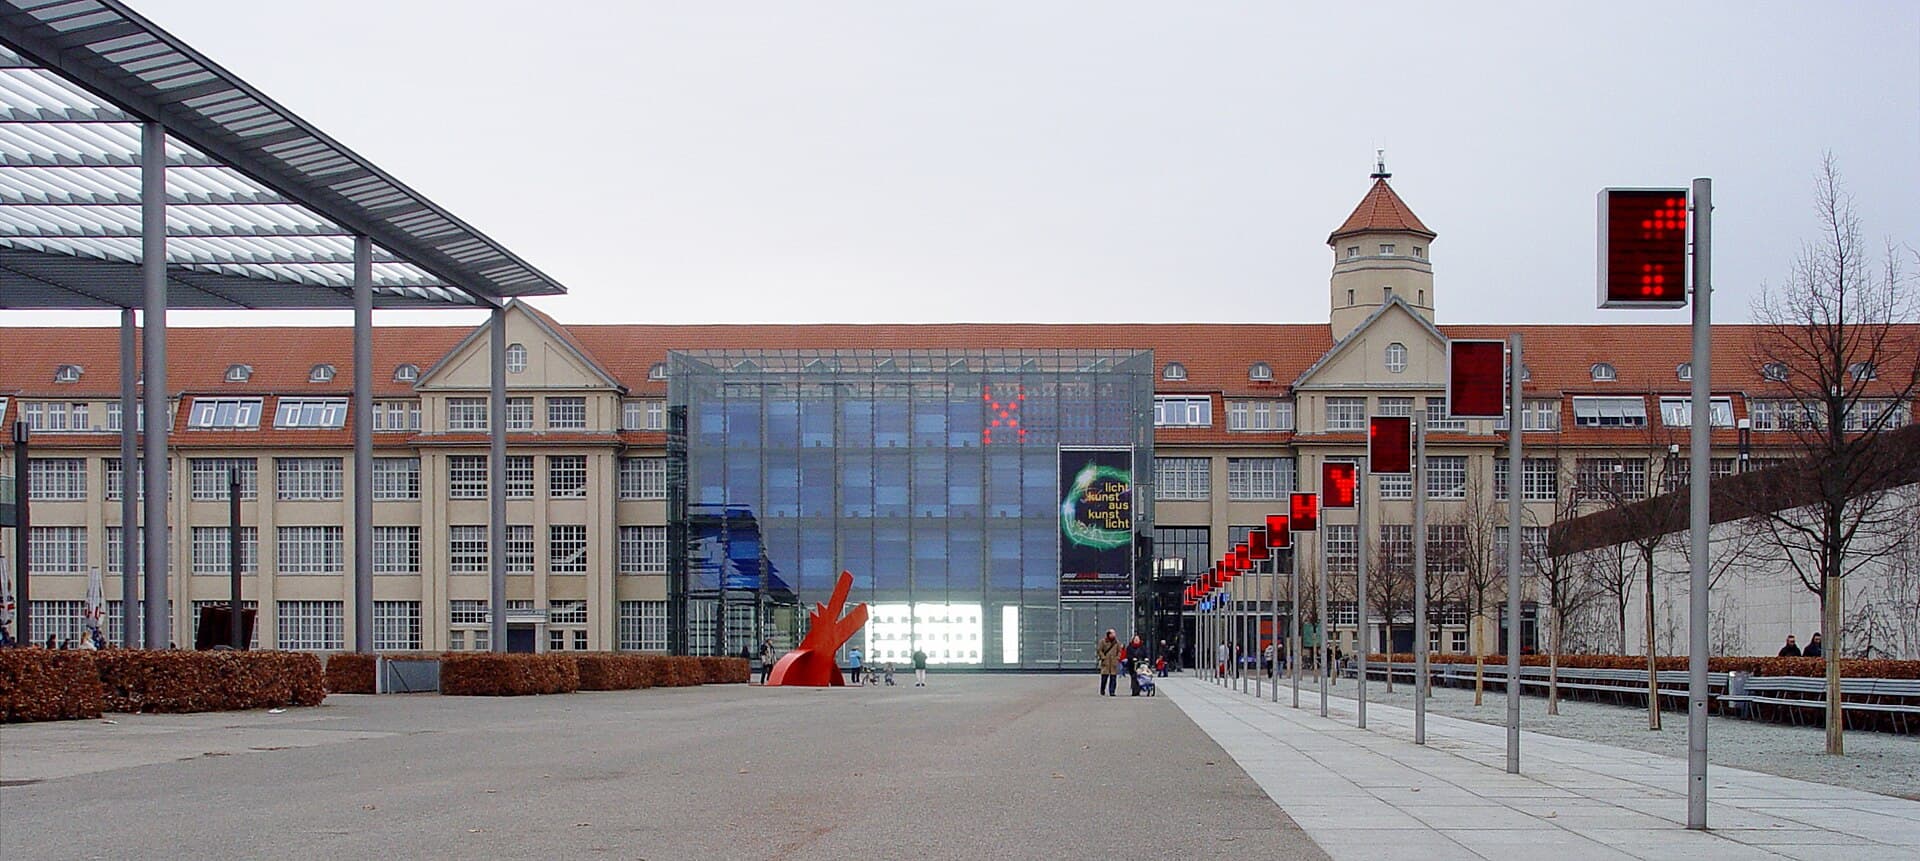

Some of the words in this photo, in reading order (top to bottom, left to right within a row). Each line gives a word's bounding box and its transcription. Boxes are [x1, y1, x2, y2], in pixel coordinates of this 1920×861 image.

[1105, 482, 1128, 492] licht
[1087, 491, 1120, 501] kunst
[1108, 502, 1129, 510] aus
[1088, 509, 1120, 519] kunst
[1105, 518, 1130, 528] licht
